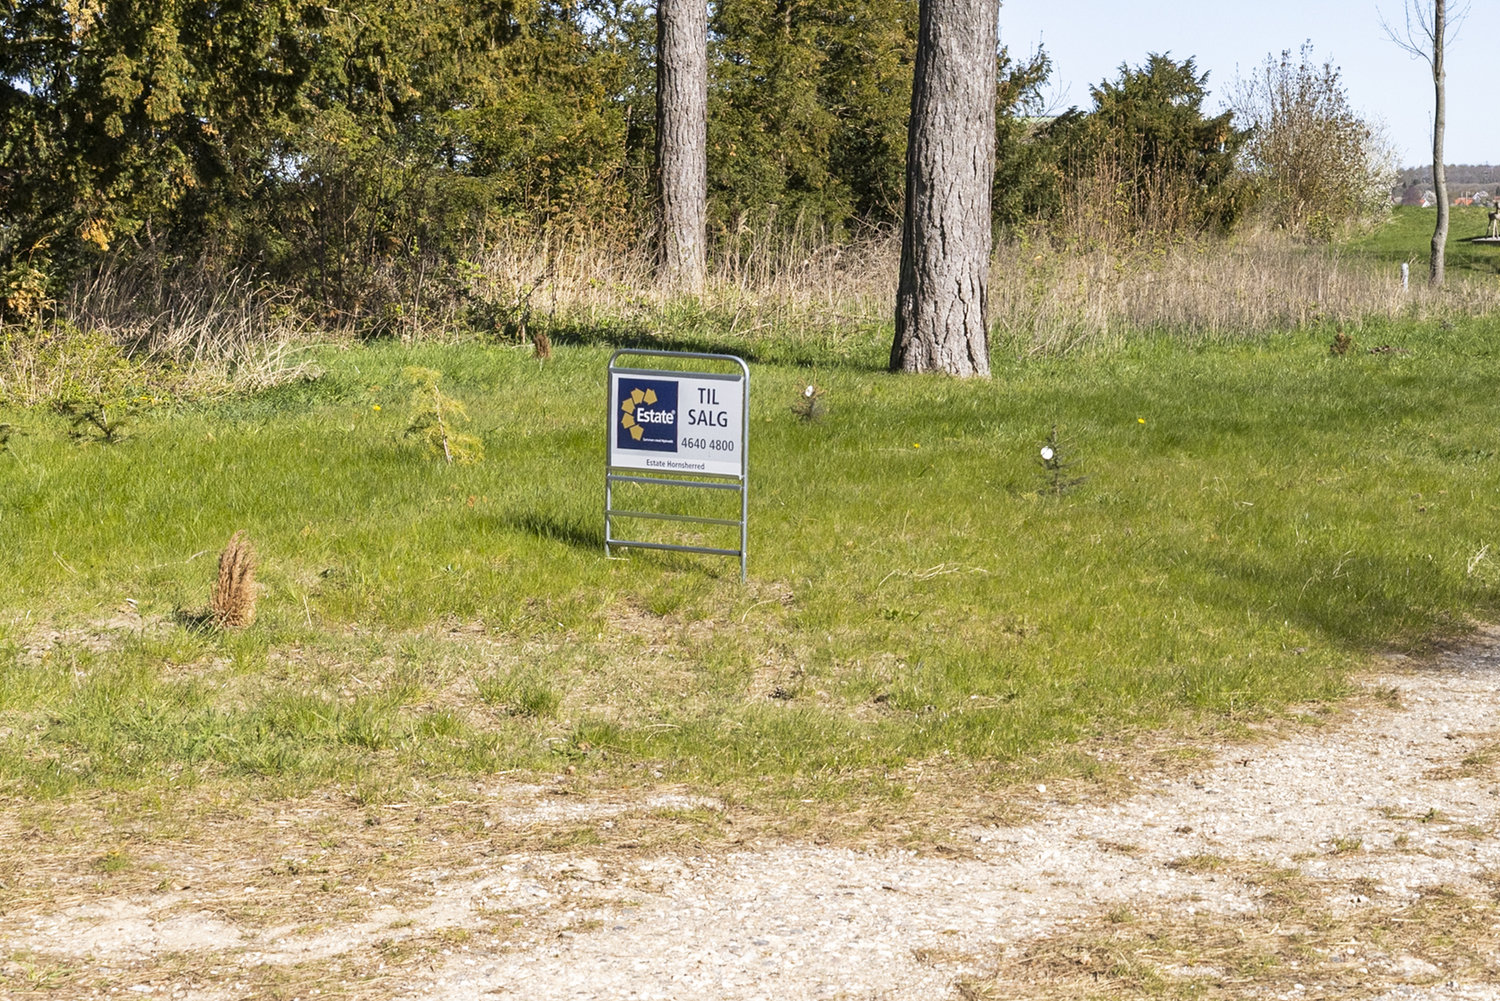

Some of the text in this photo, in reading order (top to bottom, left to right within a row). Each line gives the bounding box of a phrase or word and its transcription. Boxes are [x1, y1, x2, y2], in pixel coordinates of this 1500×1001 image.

[697, 387, 720, 405] TIL
[637, 407, 674, 424] Estate
[687, 408, 728, 427] SALG
[681, 437, 707, 450] 4640
[709, 439, 735, 452] 4800
[646, 459, 705, 470] Estate Hornsherred
